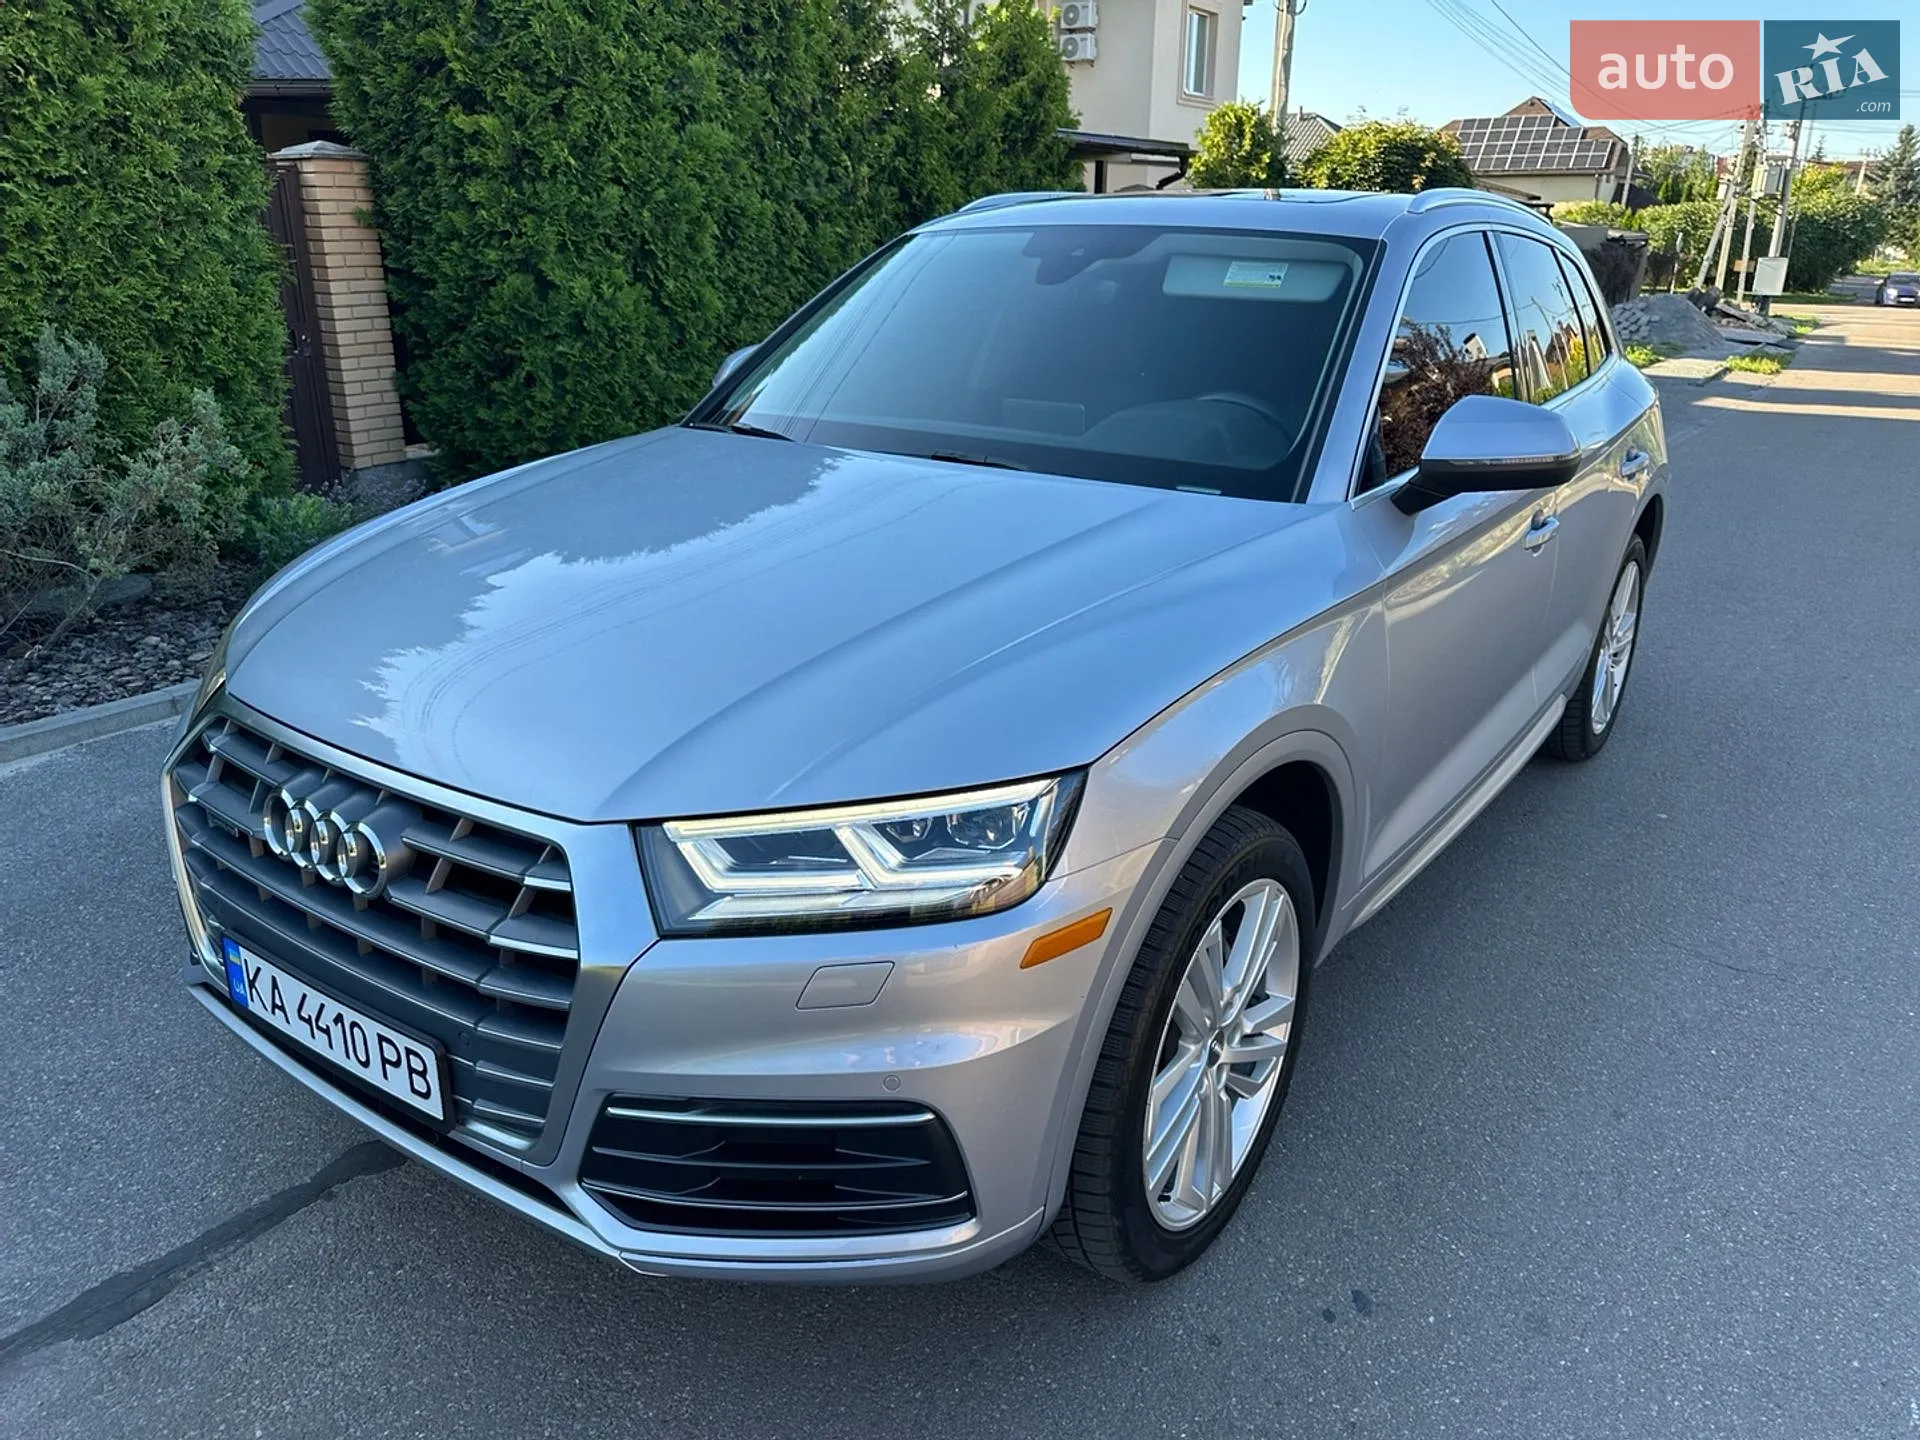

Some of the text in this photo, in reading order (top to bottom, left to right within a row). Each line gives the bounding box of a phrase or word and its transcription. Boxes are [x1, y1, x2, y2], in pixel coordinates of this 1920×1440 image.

[244, 958, 432, 1100] KA 4410 PB
